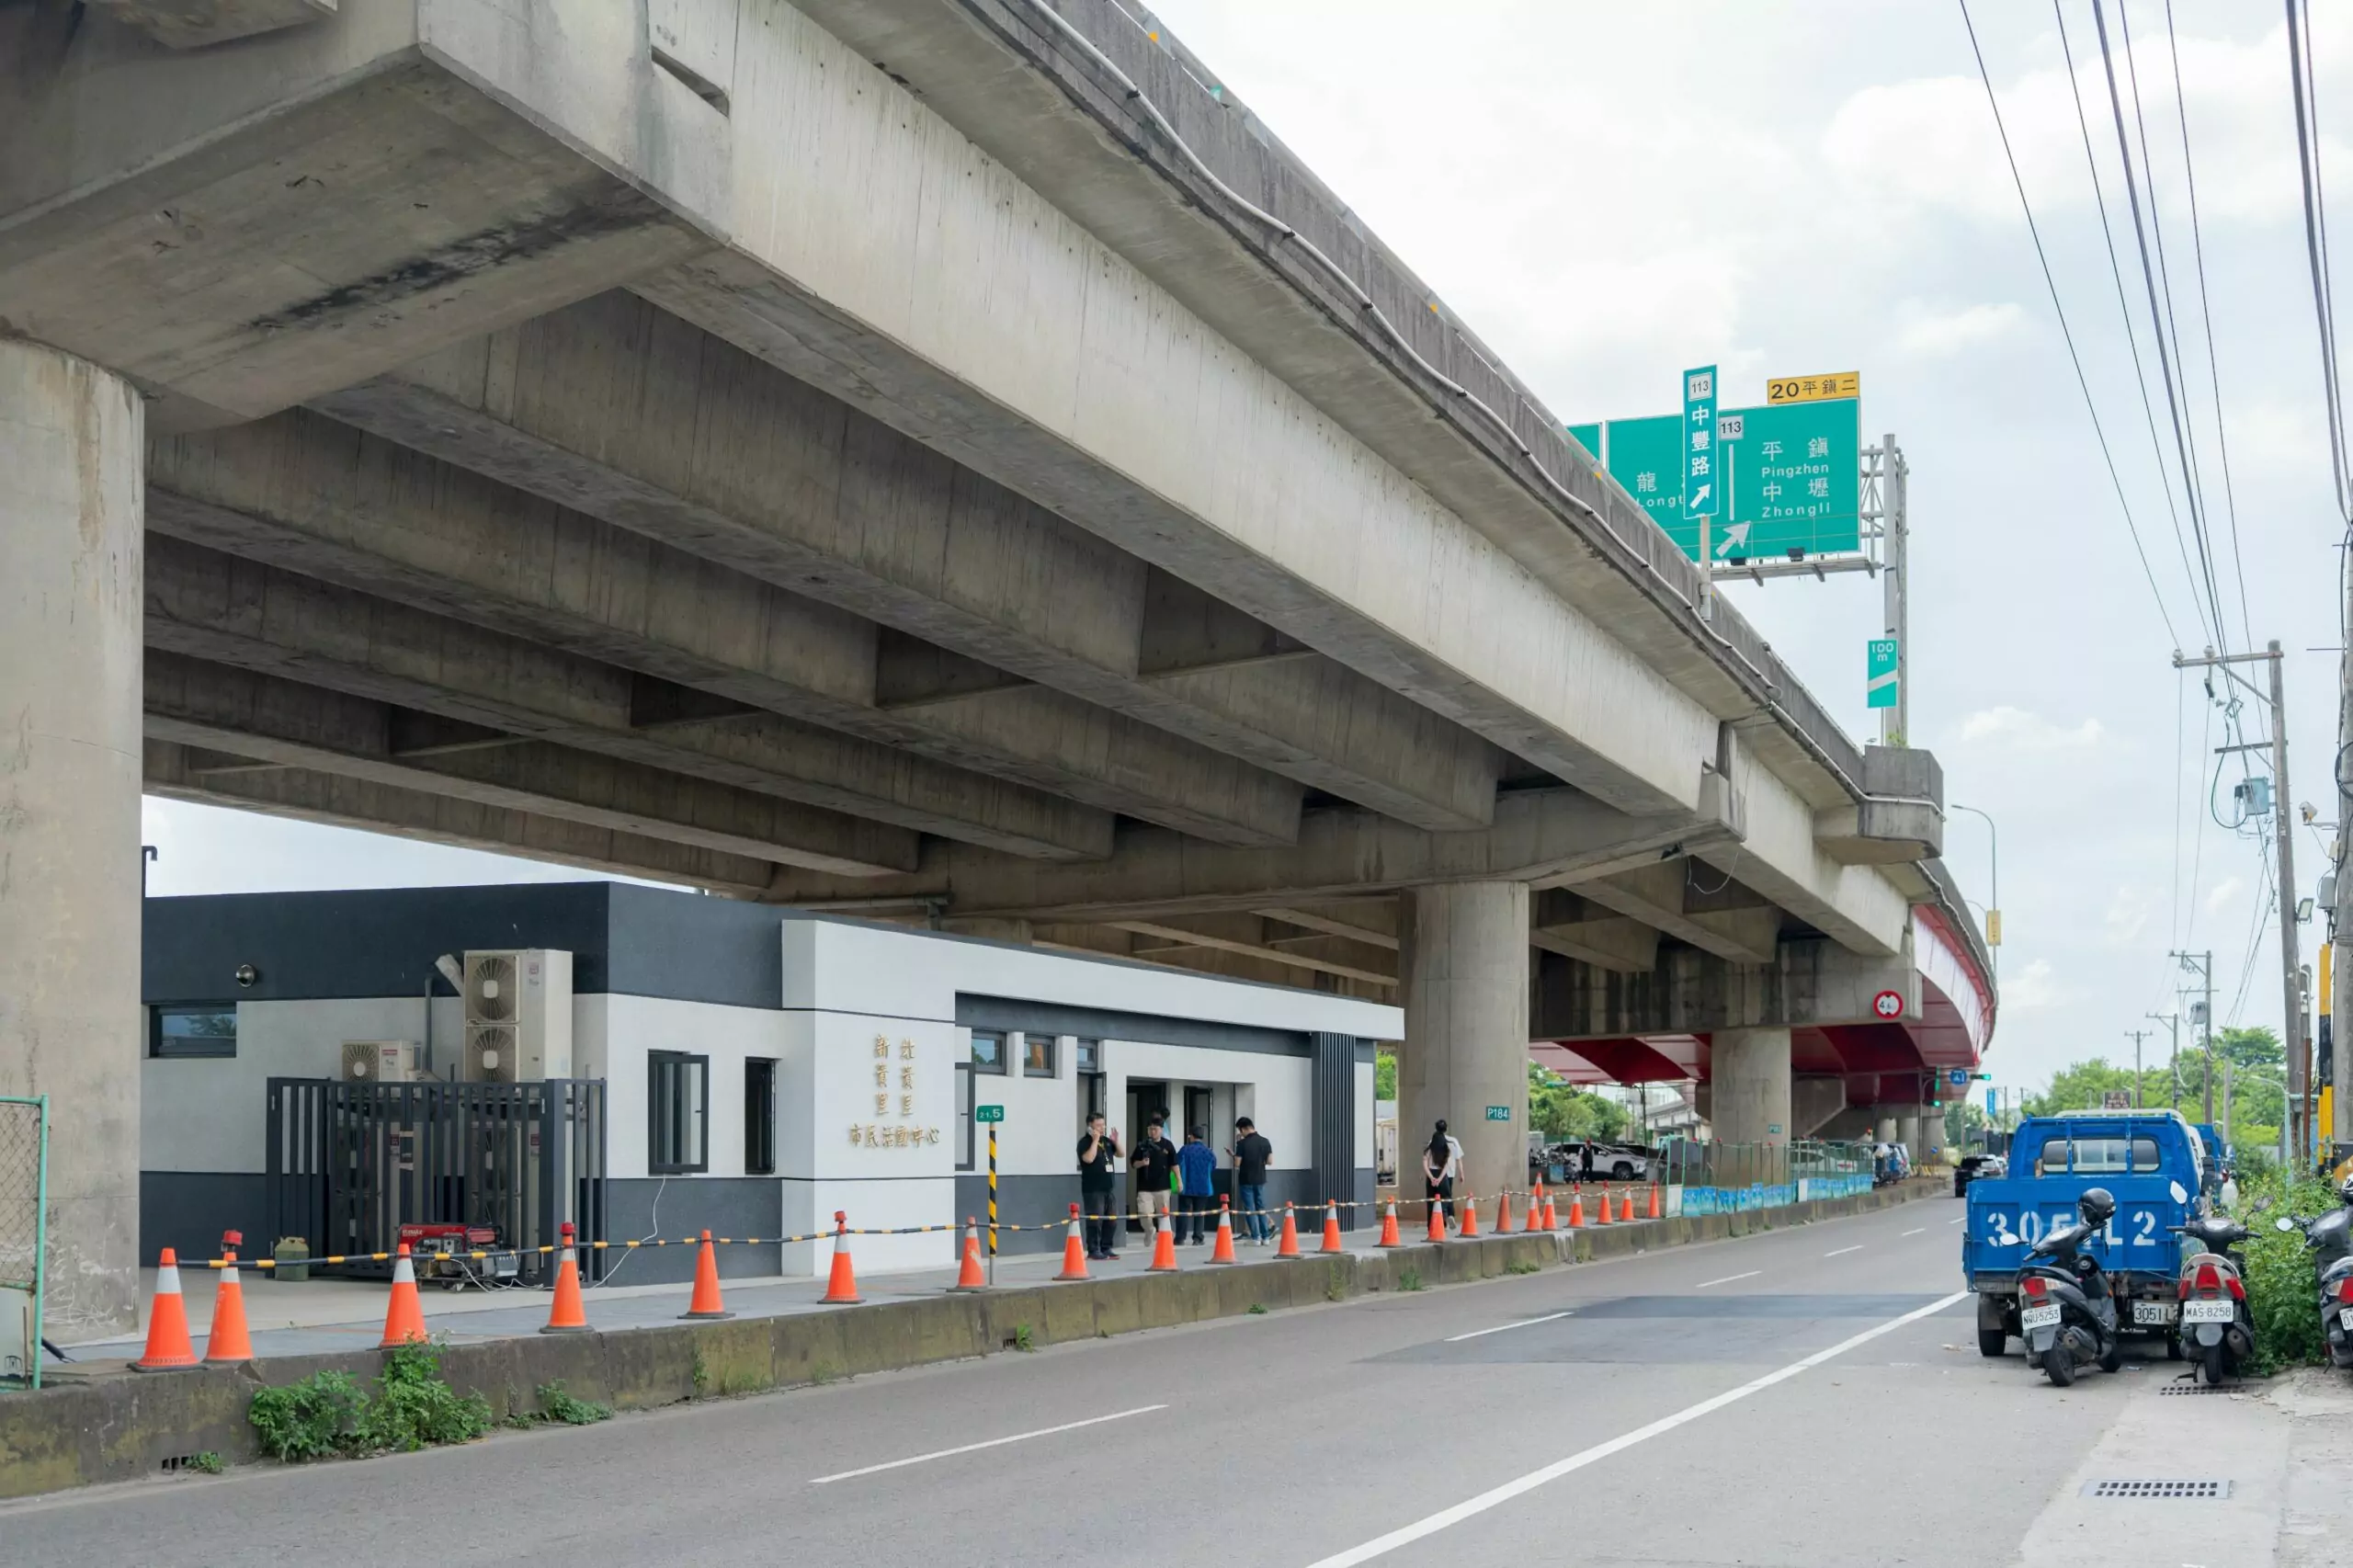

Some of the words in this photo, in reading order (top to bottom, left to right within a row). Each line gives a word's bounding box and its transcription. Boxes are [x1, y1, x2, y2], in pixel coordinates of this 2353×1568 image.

[1691, 380, 1709, 393] 113
[1721, 421, 1742, 434] 113
[1691, 404, 1711, 477] 中豐路
[1761, 437, 1829, 462] 平鎮
[1761, 463, 1829, 479] Pingzhen
[1761, 477, 1829, 503] 中壢
[1761, 502, 1830, 517] Zhongli
[1871, 642, 1894, 653] 100
[1877, 653, 1888, 662] m
[1487, 1108, 1508, 1119] P184
